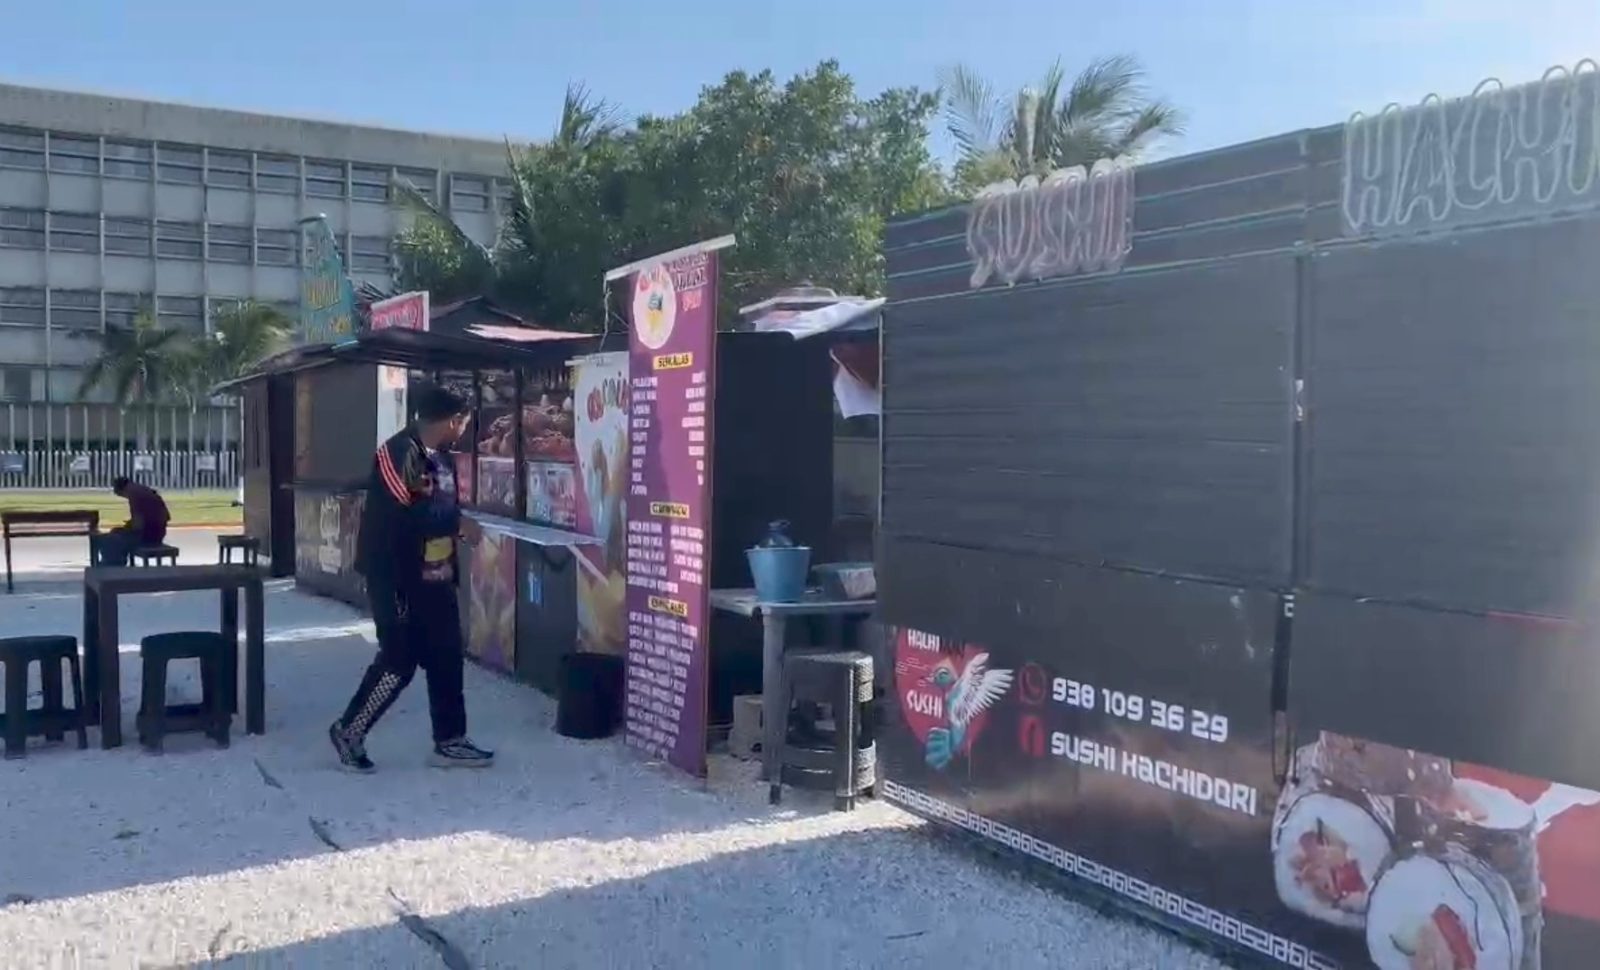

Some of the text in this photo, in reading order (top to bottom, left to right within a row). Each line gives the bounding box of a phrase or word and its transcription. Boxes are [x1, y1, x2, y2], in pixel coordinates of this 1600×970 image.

[967, 158, 1134, 288] SUSHI
[906, 689, 943, 719] SUSHI
[1053, 677, 1229, 743] 938 109 36 29
[1051, 732, 1115, 771] SUSHI
